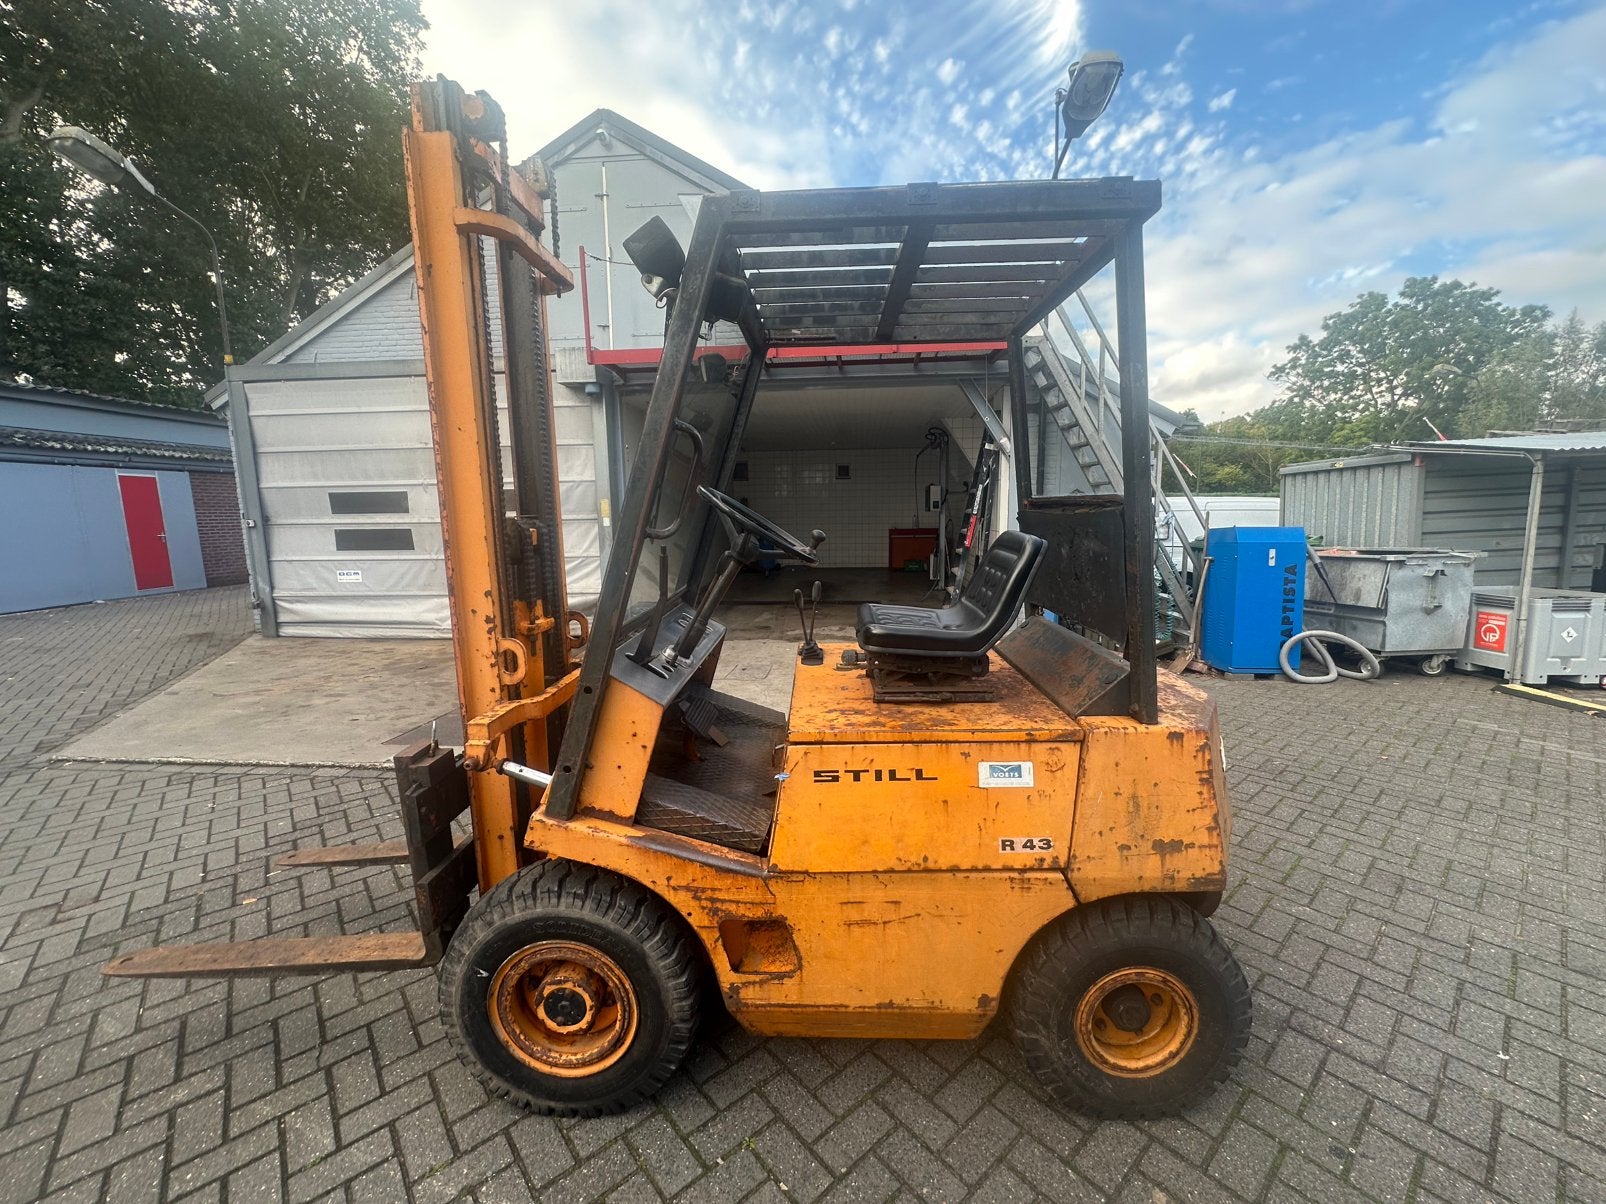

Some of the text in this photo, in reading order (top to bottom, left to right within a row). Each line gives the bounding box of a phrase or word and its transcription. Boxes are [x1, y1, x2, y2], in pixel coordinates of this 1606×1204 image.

[813, 769, 938, 783] STILL
[1001, 838, 1052, 851] R 43
